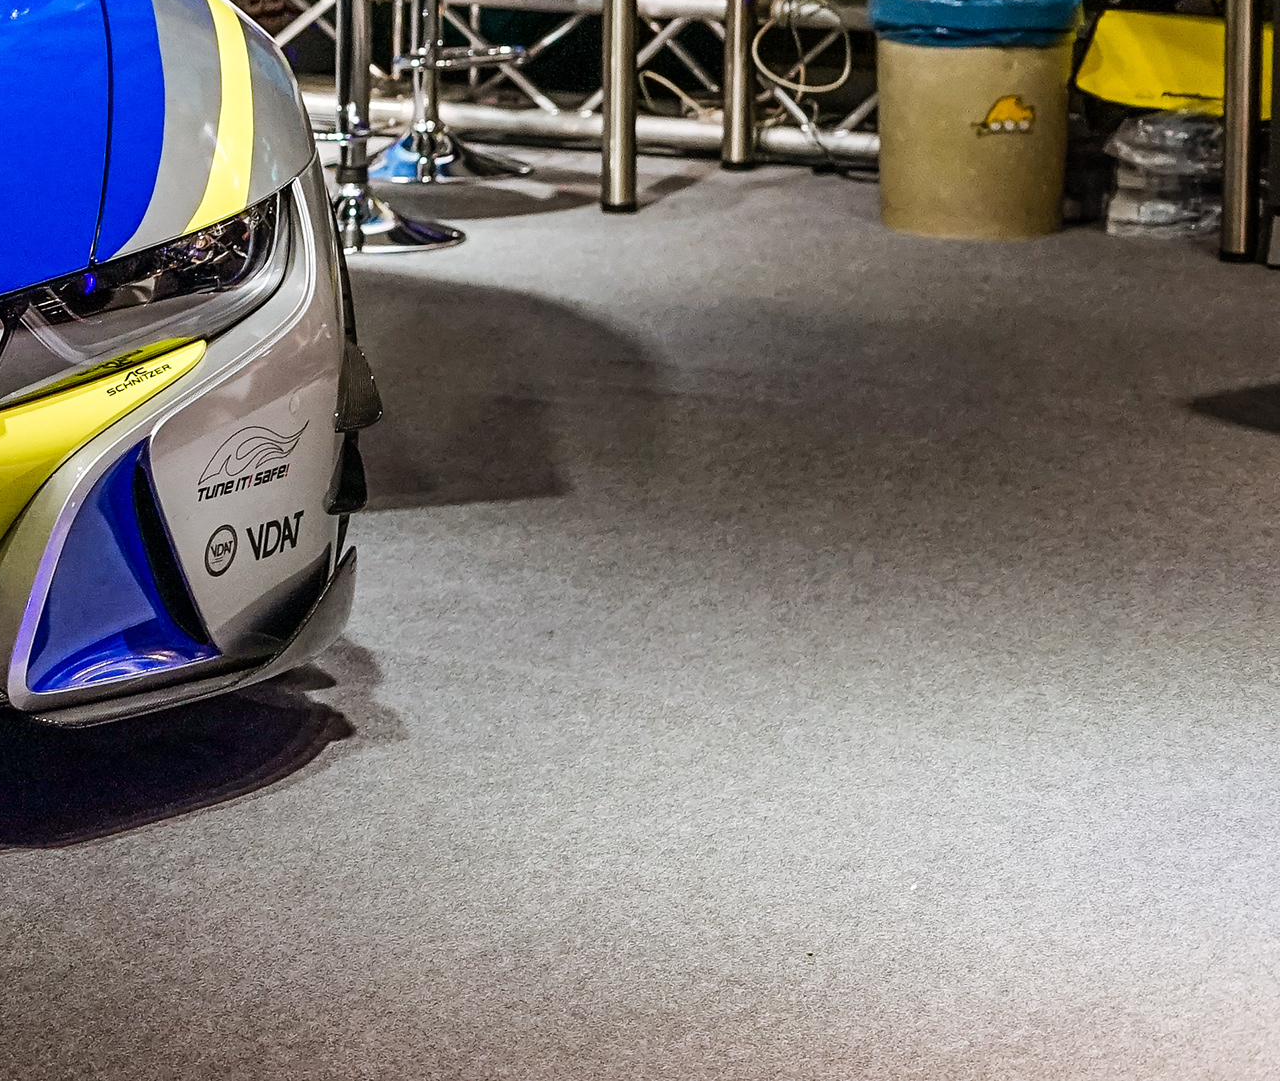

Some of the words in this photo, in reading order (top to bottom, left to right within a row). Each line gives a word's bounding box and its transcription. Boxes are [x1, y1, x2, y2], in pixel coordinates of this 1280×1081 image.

[106, 363, 173, 397] SCHNITZER
[235, 474, 253, 493] IT!
[246, 510, 305, 561] VDAT
